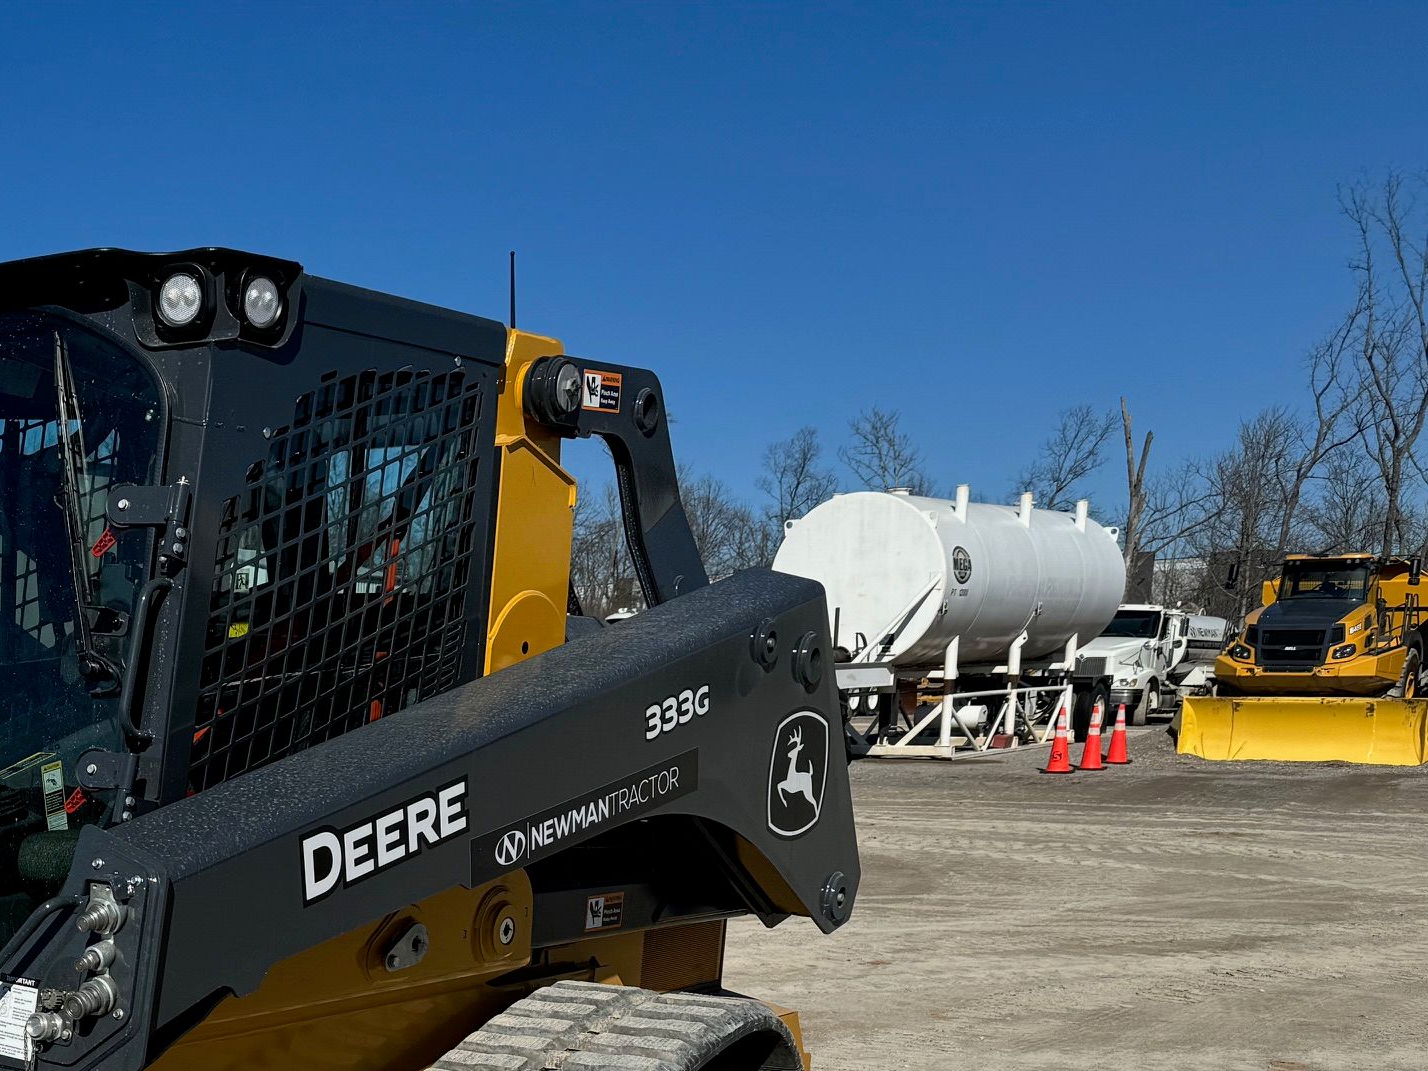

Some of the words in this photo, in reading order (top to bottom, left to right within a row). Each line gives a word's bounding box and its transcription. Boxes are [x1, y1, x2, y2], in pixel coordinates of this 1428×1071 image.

[953, 557, 972, 571] MEGA
[645, 685, 710, 740] 333G
[302, 781, 467, 901] DEERE
